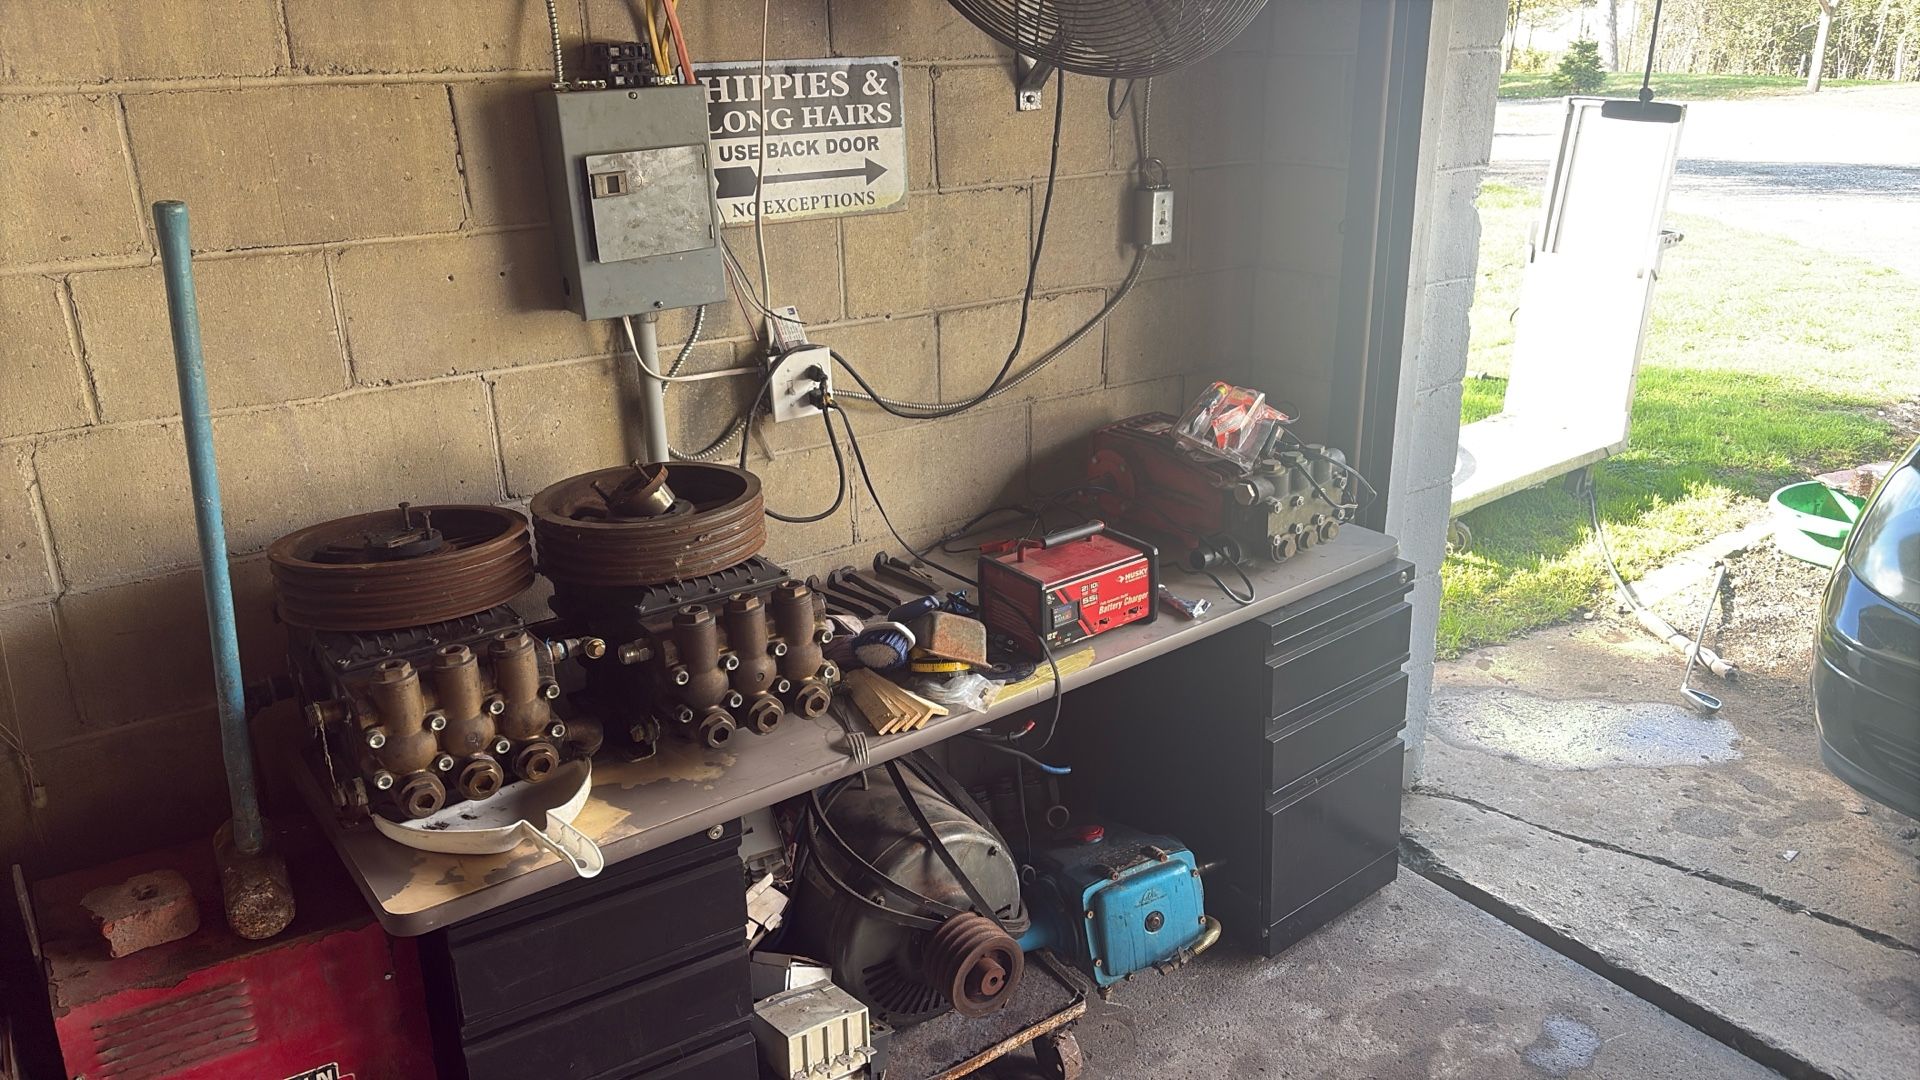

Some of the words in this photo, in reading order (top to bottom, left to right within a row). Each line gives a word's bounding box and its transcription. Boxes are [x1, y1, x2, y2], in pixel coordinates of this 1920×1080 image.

[699, 71, 850, 103] HIPPIES
[862, 69, 888, 96] &
[708, 108, 794, 134] LONG
[801, 102, 892, 128] HAIRS
[719, 144, 760, 162] USE
[767, 139, 820, 159] BACK
[826, 135, 880, 154] DOOR
[732, 202, 758, 218] NO
[763, 190, 876, 215] EXCEPTIONS
[1124, 567, 1148, 581] HUSKY
[1098, 601, 1123, 615] Battery
[1123, 592, 1149, 606] Charger
